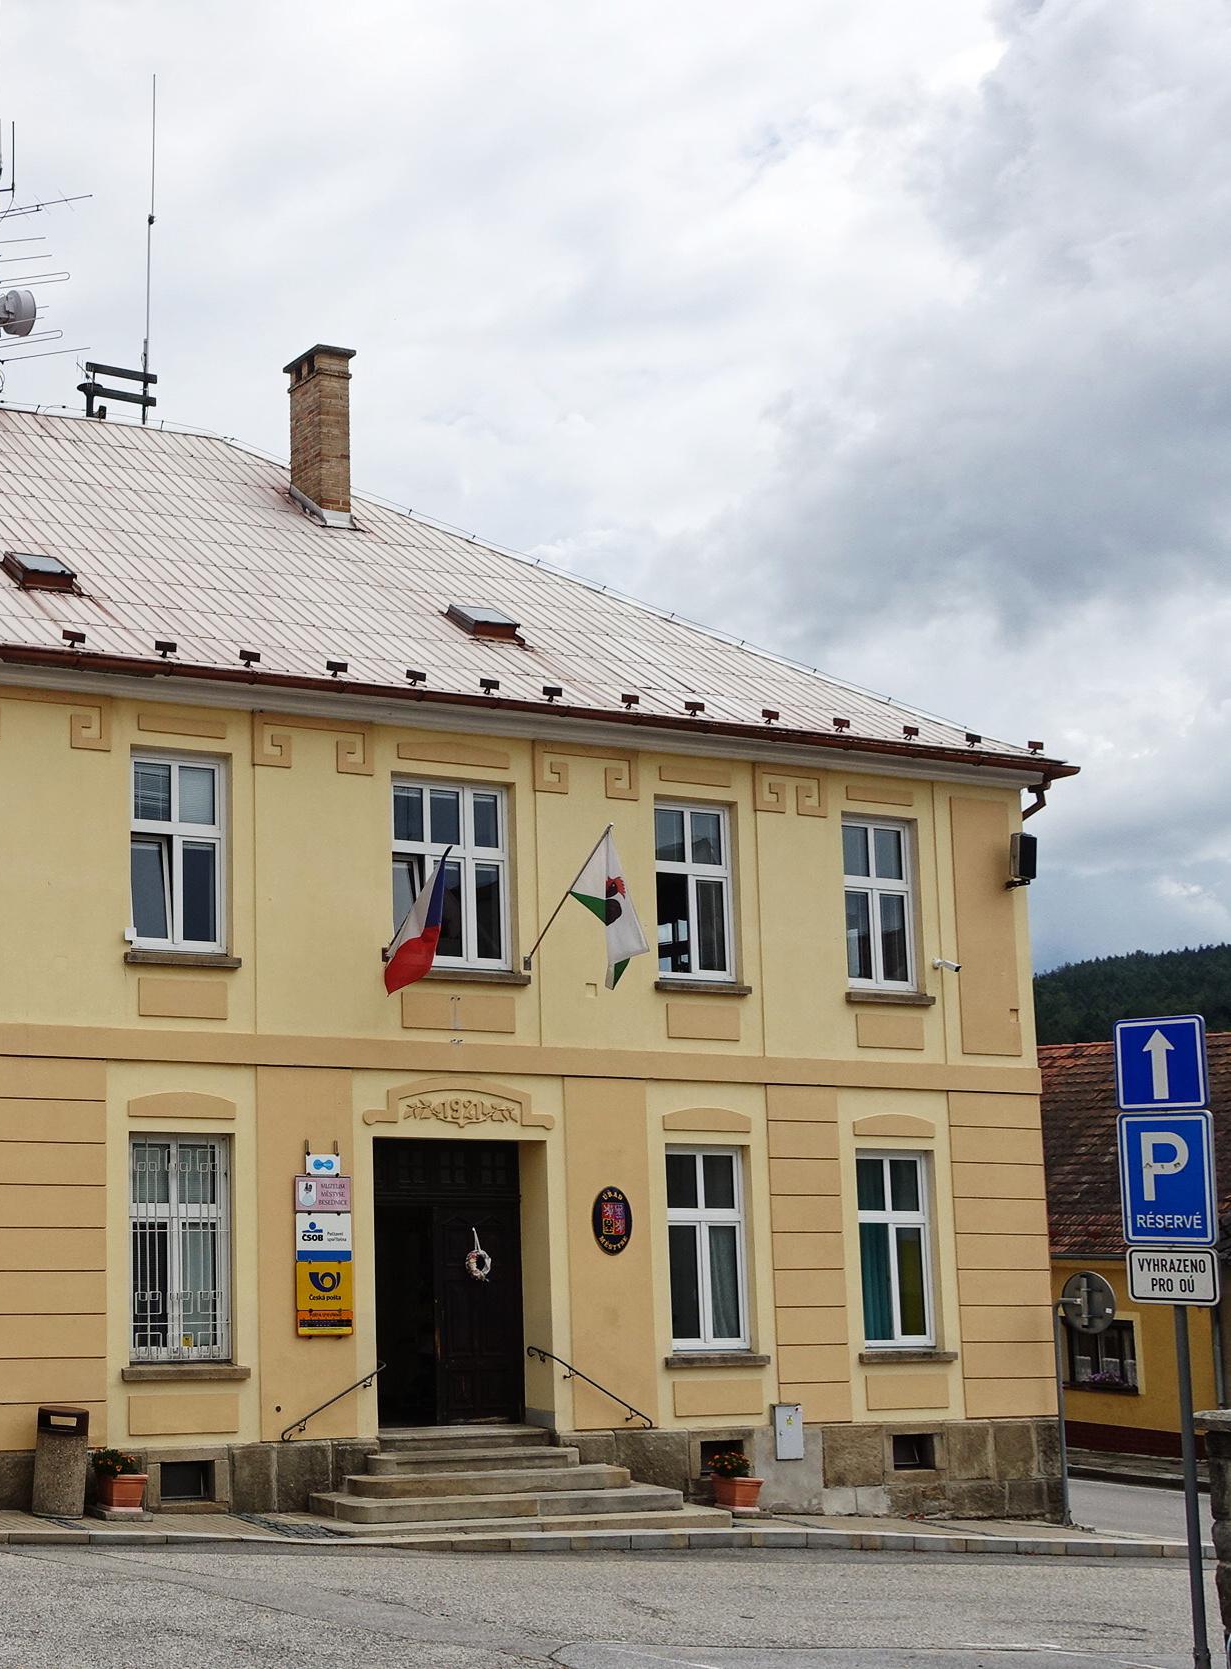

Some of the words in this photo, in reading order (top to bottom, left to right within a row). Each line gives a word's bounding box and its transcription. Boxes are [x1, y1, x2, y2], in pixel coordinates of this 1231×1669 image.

[440, 1099, 479, 1120] 1921
[1140, 1131, 1189, 1202] P
[1136, 1211, 1203, 1229] RÉSERVÉ
[301, 1233, 324, 1242] ČSOB
[1137, 1257, 1206, 1274] VYHRAZENO
[1151, 1277, 1174, 1293] PRO
[1179, 1275, 1195, 1293] OÚ
[326, 1294, 342, 1302] pošta
